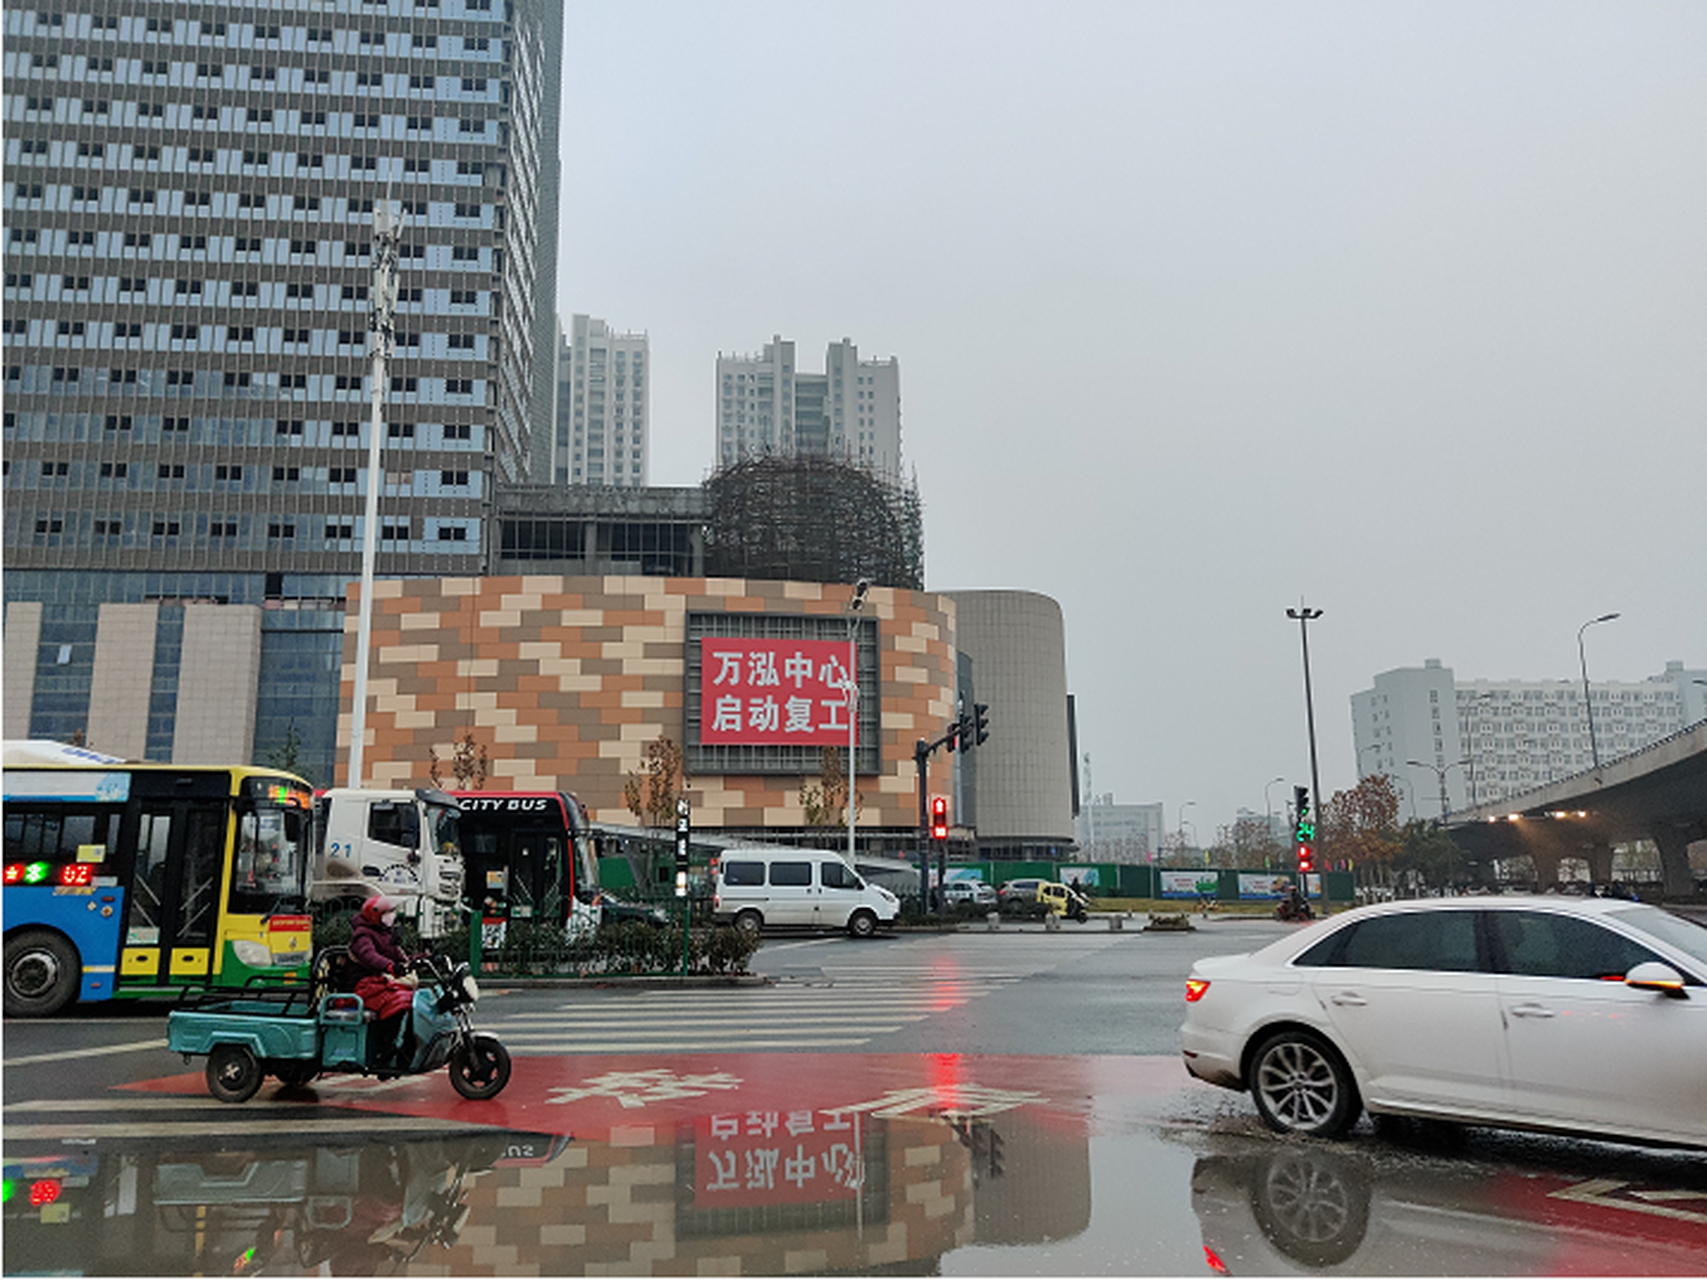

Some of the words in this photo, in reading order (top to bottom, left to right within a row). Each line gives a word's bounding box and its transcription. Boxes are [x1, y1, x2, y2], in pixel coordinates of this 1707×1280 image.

[712, 651, 849, 688] 万泓中心
[712, 694, 849, 733] 启动复工
[459, 799, 504, 811] CITY
[506, 799, 548, 811] BUS
[1296, 822, 1315, 842] 24
[330, 842, 352, 858] 21
